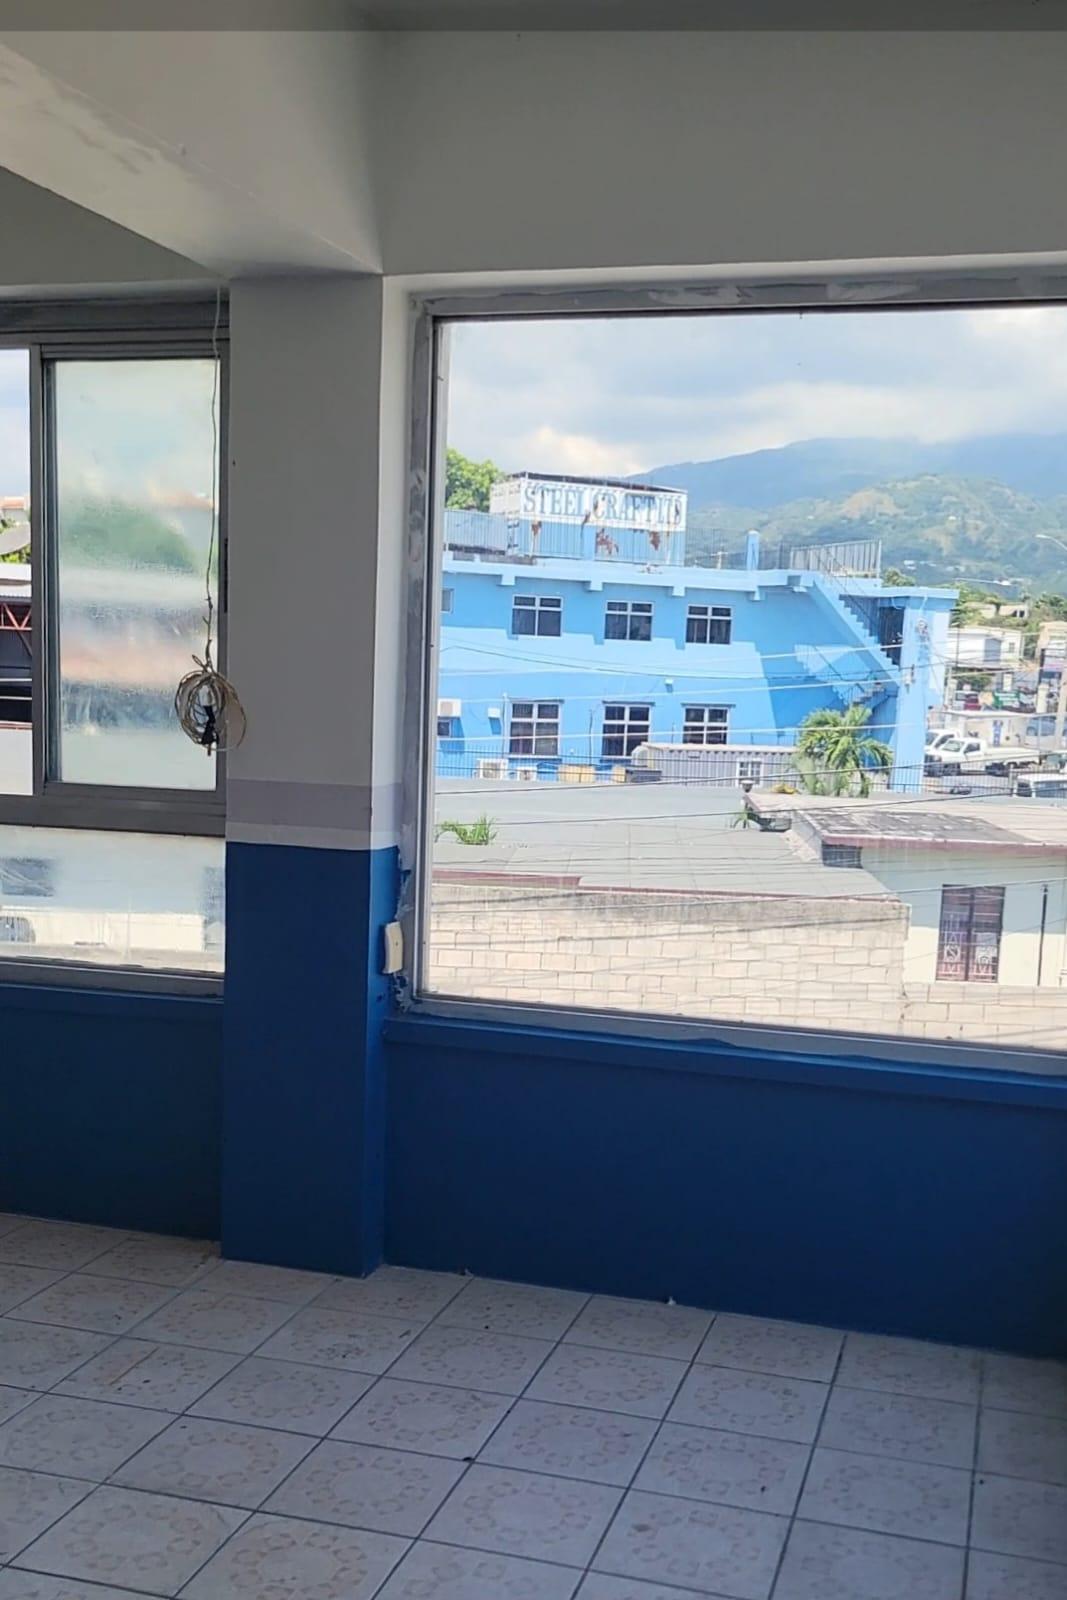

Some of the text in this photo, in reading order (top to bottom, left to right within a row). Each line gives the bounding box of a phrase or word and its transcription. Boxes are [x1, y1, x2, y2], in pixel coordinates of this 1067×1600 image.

[525, 488, 682, 525] STEEL CRAFT LTD
